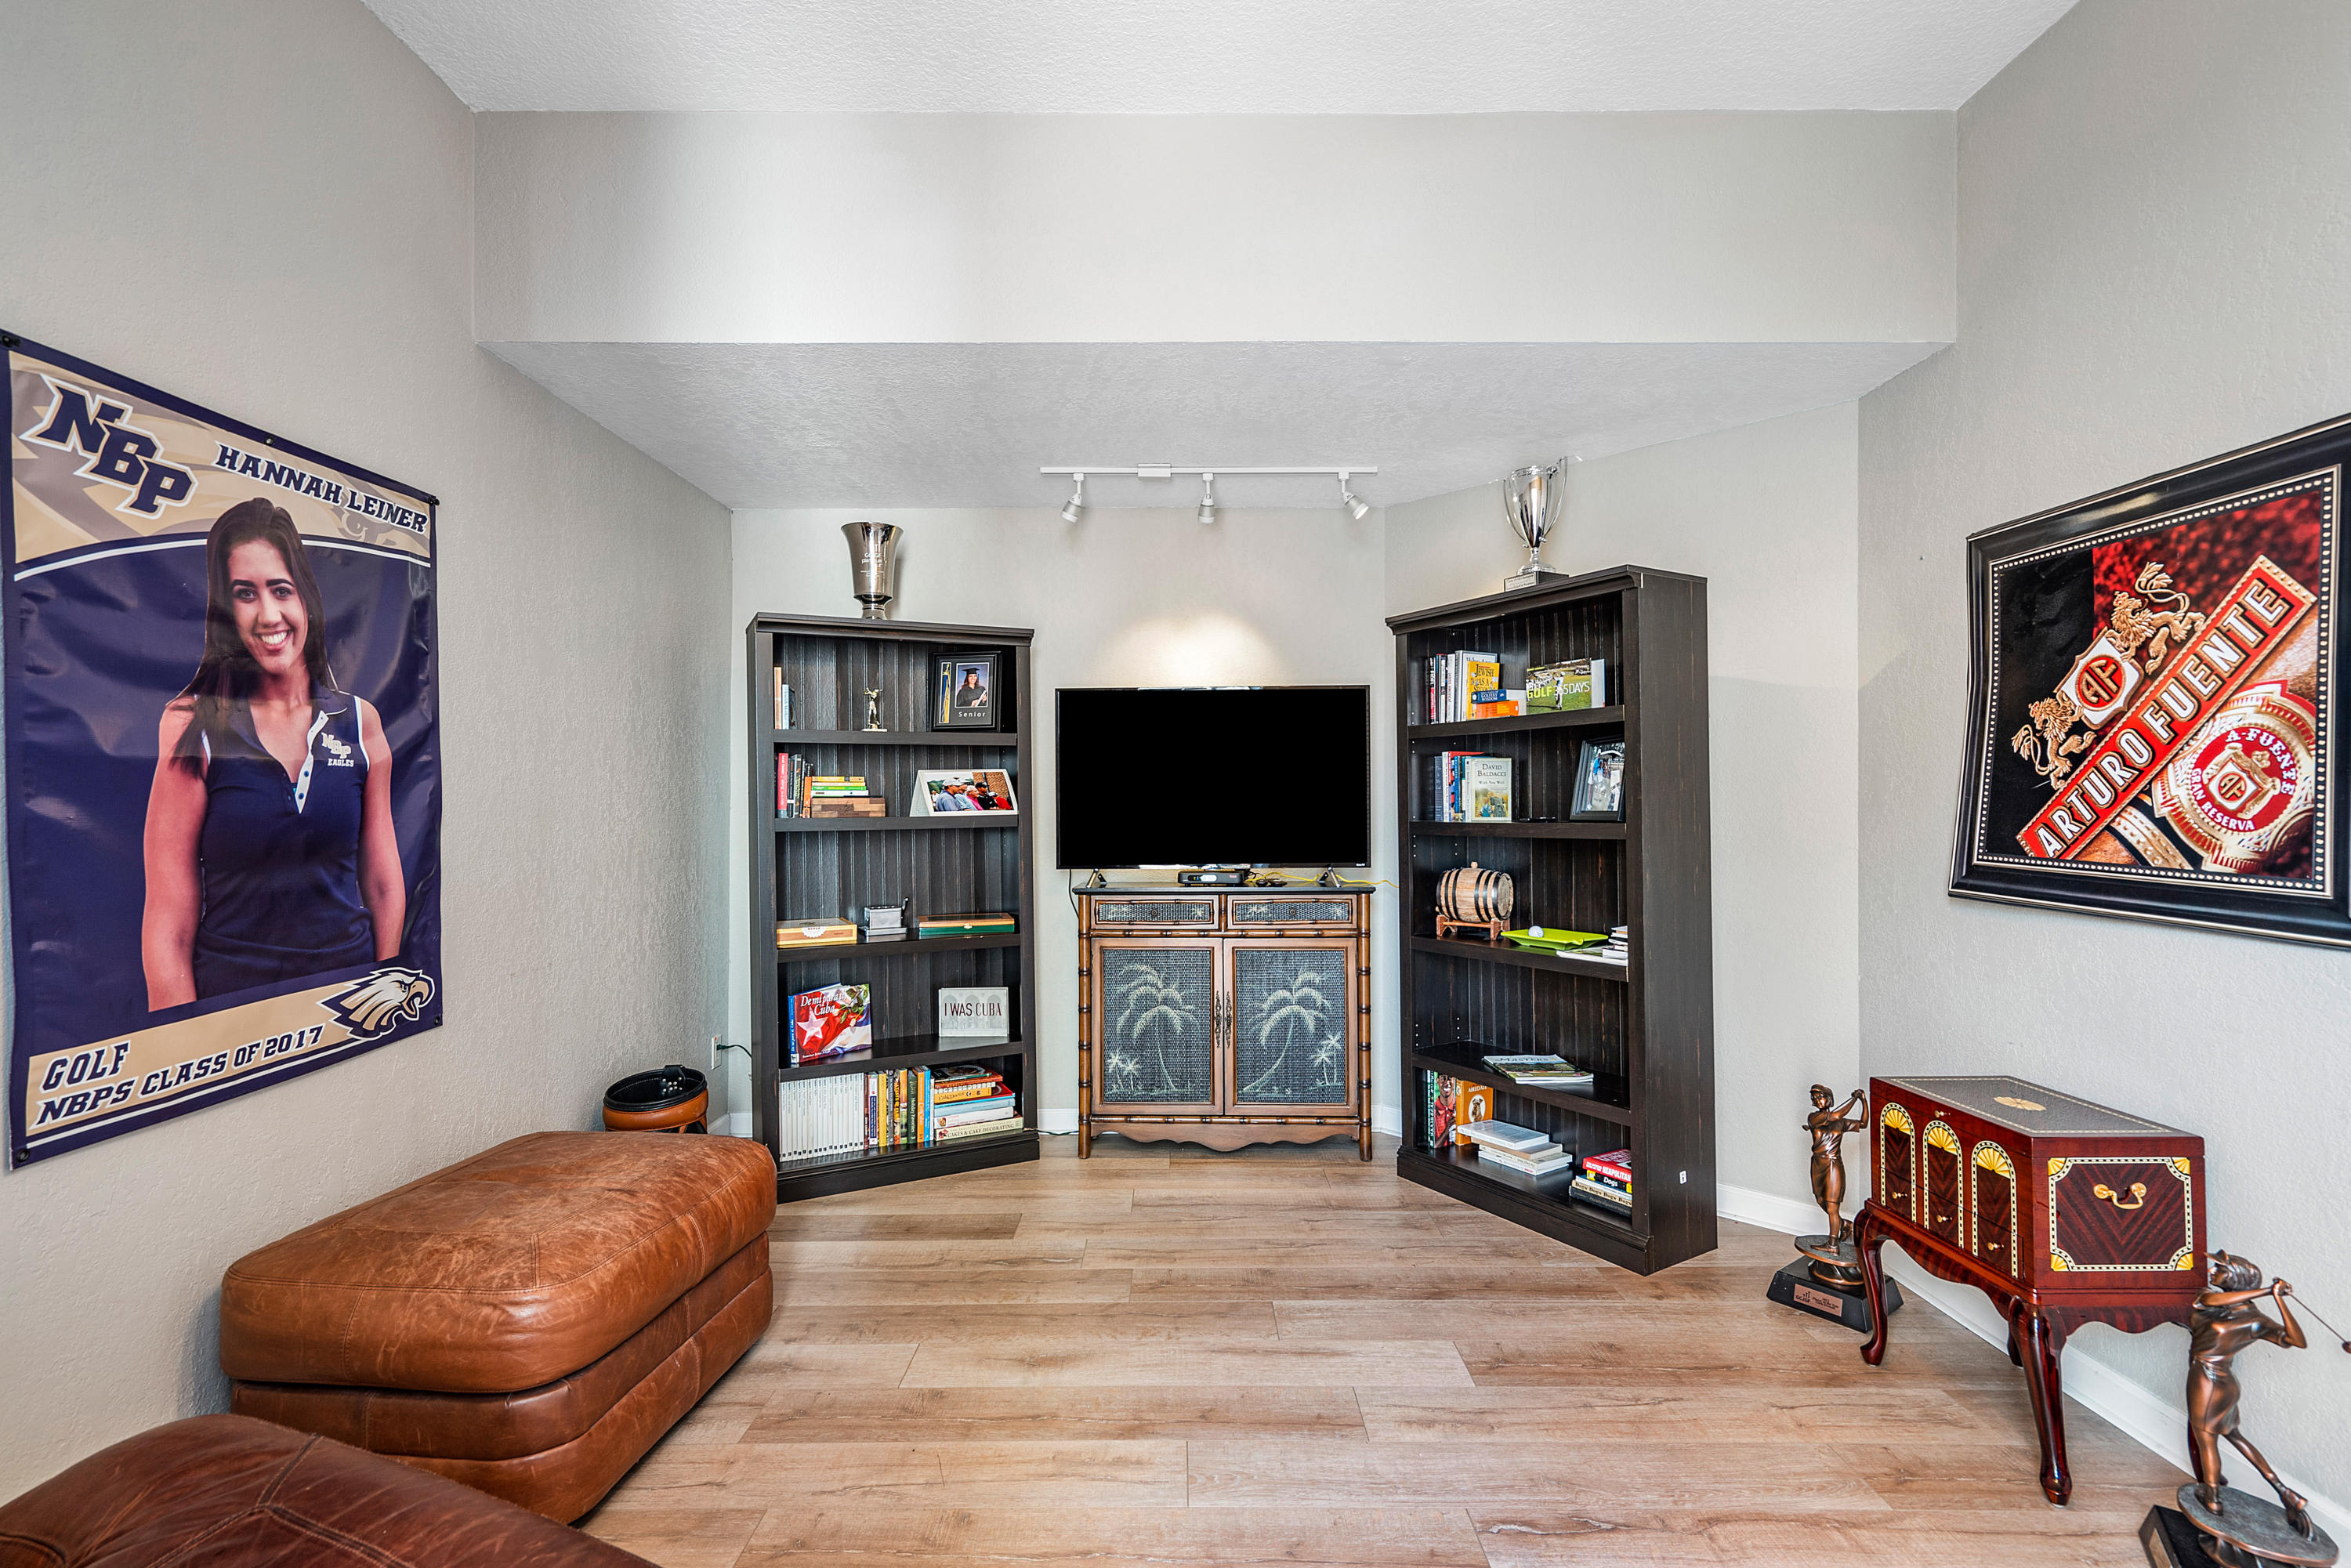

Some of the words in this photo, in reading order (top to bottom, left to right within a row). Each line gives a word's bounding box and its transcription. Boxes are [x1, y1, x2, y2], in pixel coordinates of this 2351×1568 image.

[20, 375, 198, 520] NBP
[216, 442, 342, 506] HANNAH
[346, 489, 428, 533] LEINER
[1474, 664, 1494, 678] JEWISH
[1527, 686, 1552, 698] GOLF
[2037, 727, 2154, 858] ARTURO
[2140, 578, 2290, 744] FUENTE
[321, 733, 351, 759] NBP
[328, 759, 354, 767] EAGLES
[2190, 767, 2206, 801] GRAN
[2201, 802, 2255, 831] RESERVA
[801, 995, 811, 1007] De
[821, 994, 840, 1007] para
[814, 1003, 836, 1016] Cuba
[944, 1002, 947, 1016] I
[950, 1002, 973, 1016] WAS
[976, 1002, 1002, 1016] CUBA
[42, 1041, 129, 1090] GOLF
[35, 1079, 136, 1126] NBPS
[139, 1053, 228, 1096] CLASS
[233, 1042, 260, 1067] OF
[263, 1026, 323, 1058] 2017
[983, 1124, 1014, 1132] DECORATING
[1603, 1176, 1618, 1186] Dogs
[1575, 1182, 1588, 1190] Dogs
[1588, 1186, 1602, 1195] Dogs
[1603, 1192, 1616, 1200] Dogs
